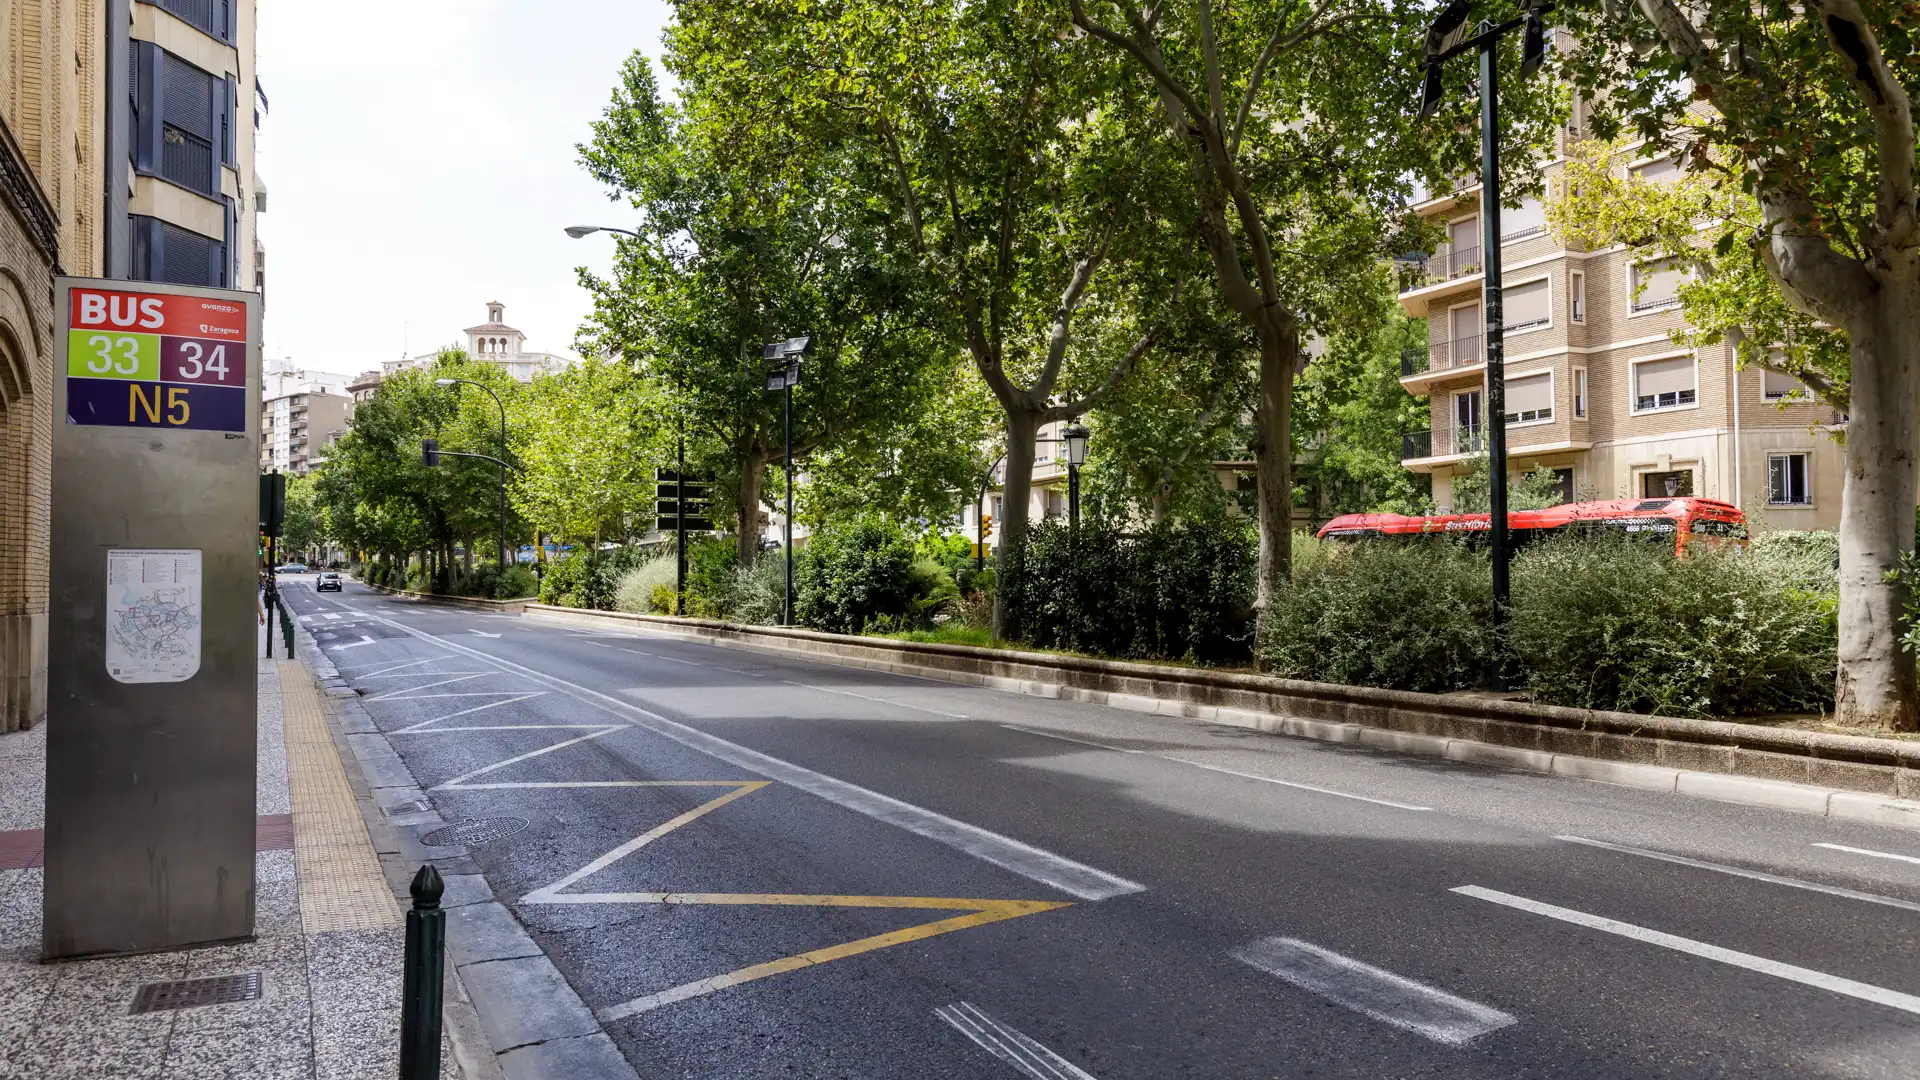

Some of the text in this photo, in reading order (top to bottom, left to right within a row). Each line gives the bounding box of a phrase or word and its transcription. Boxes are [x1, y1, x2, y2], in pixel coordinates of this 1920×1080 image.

[81, 293, 165, 329] BUS
[201, 303, 232, 311] avanza
[209, 325, 239, 334] Zaragoza
[87, 335, 140, 375] 33
[178, 341, 230, 381] 34
[129, 383, 190, 425] N5
